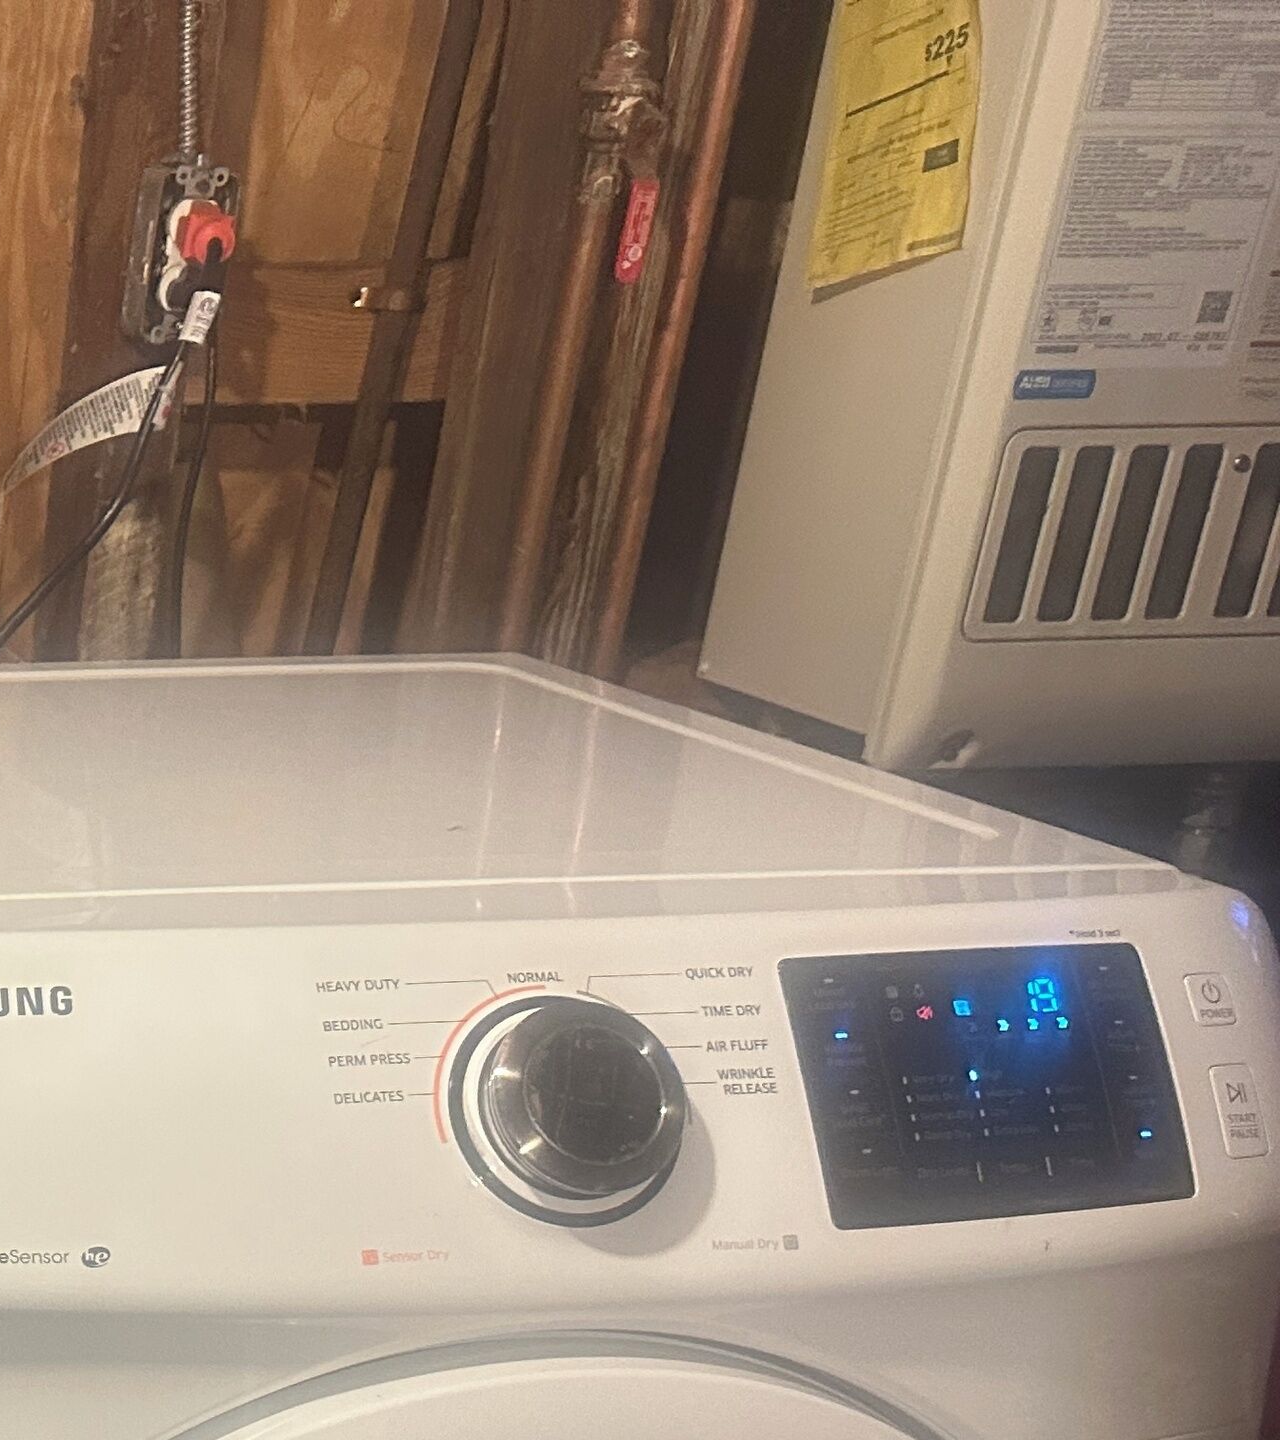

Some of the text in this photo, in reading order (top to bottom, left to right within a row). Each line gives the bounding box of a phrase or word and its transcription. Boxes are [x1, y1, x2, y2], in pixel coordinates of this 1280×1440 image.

[925, 22, 970, 62] $225
[506, 971, 564, 984] NORMAL
[685, 966, 754, 980] QUICK DRY
[316, 978, 400, 993] HEAVY DUTY
[701, 1004, 761, 1017] TIME DRY
[1199, 1007, 1234, 1019] POWER
[322, 1018, 383, 1032] BEDDING
[706, 1039, 768, 1052] AIR FLUFF
[328, 1052, 411, 1067] PERM PRESS
[716, 1067, 776, 1080] WRINKLE
[723, 1082, 778, 1095] RELEASE
[333, 1090, 404, 1105] DELICATES
[1226, 1113, 1257, 1124] START
[712, 1238, 779, 1251] Manual Dry
[382, 1249, 449, 1262] Sensor Dry
